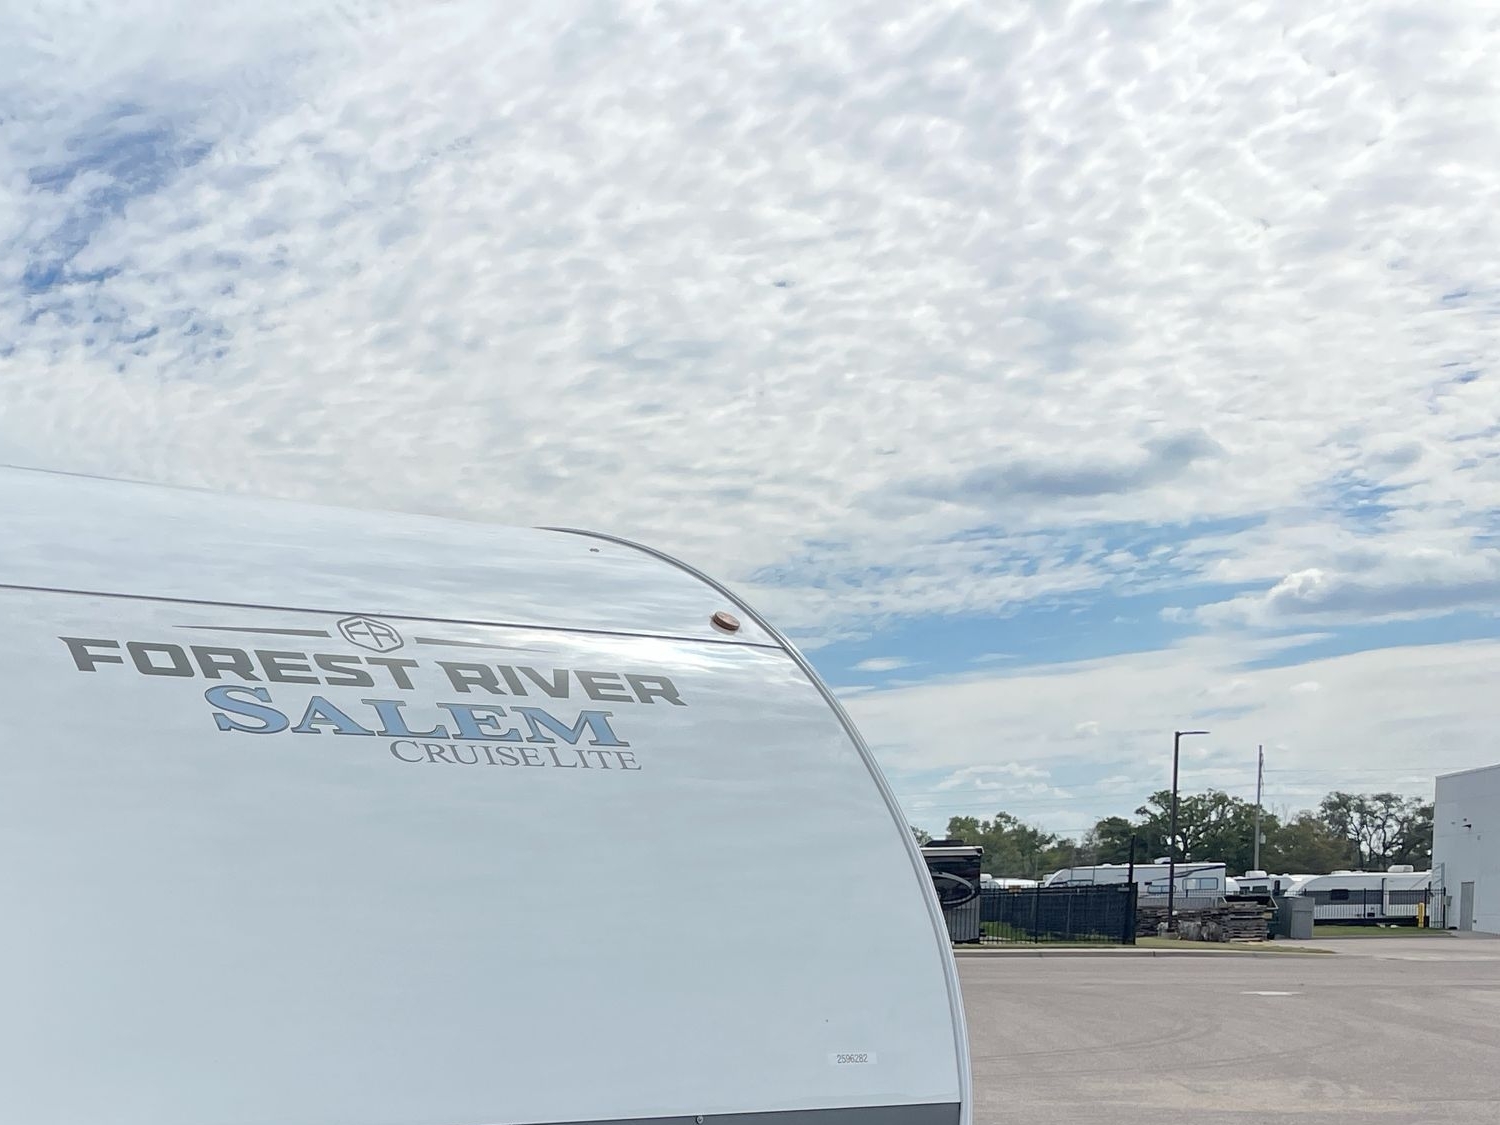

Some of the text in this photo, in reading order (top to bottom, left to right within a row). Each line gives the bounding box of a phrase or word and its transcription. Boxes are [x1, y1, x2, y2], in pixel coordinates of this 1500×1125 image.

[57, 636, 689, 706] FOREST RIVER
[204, 684, 631, 747] SALEM
